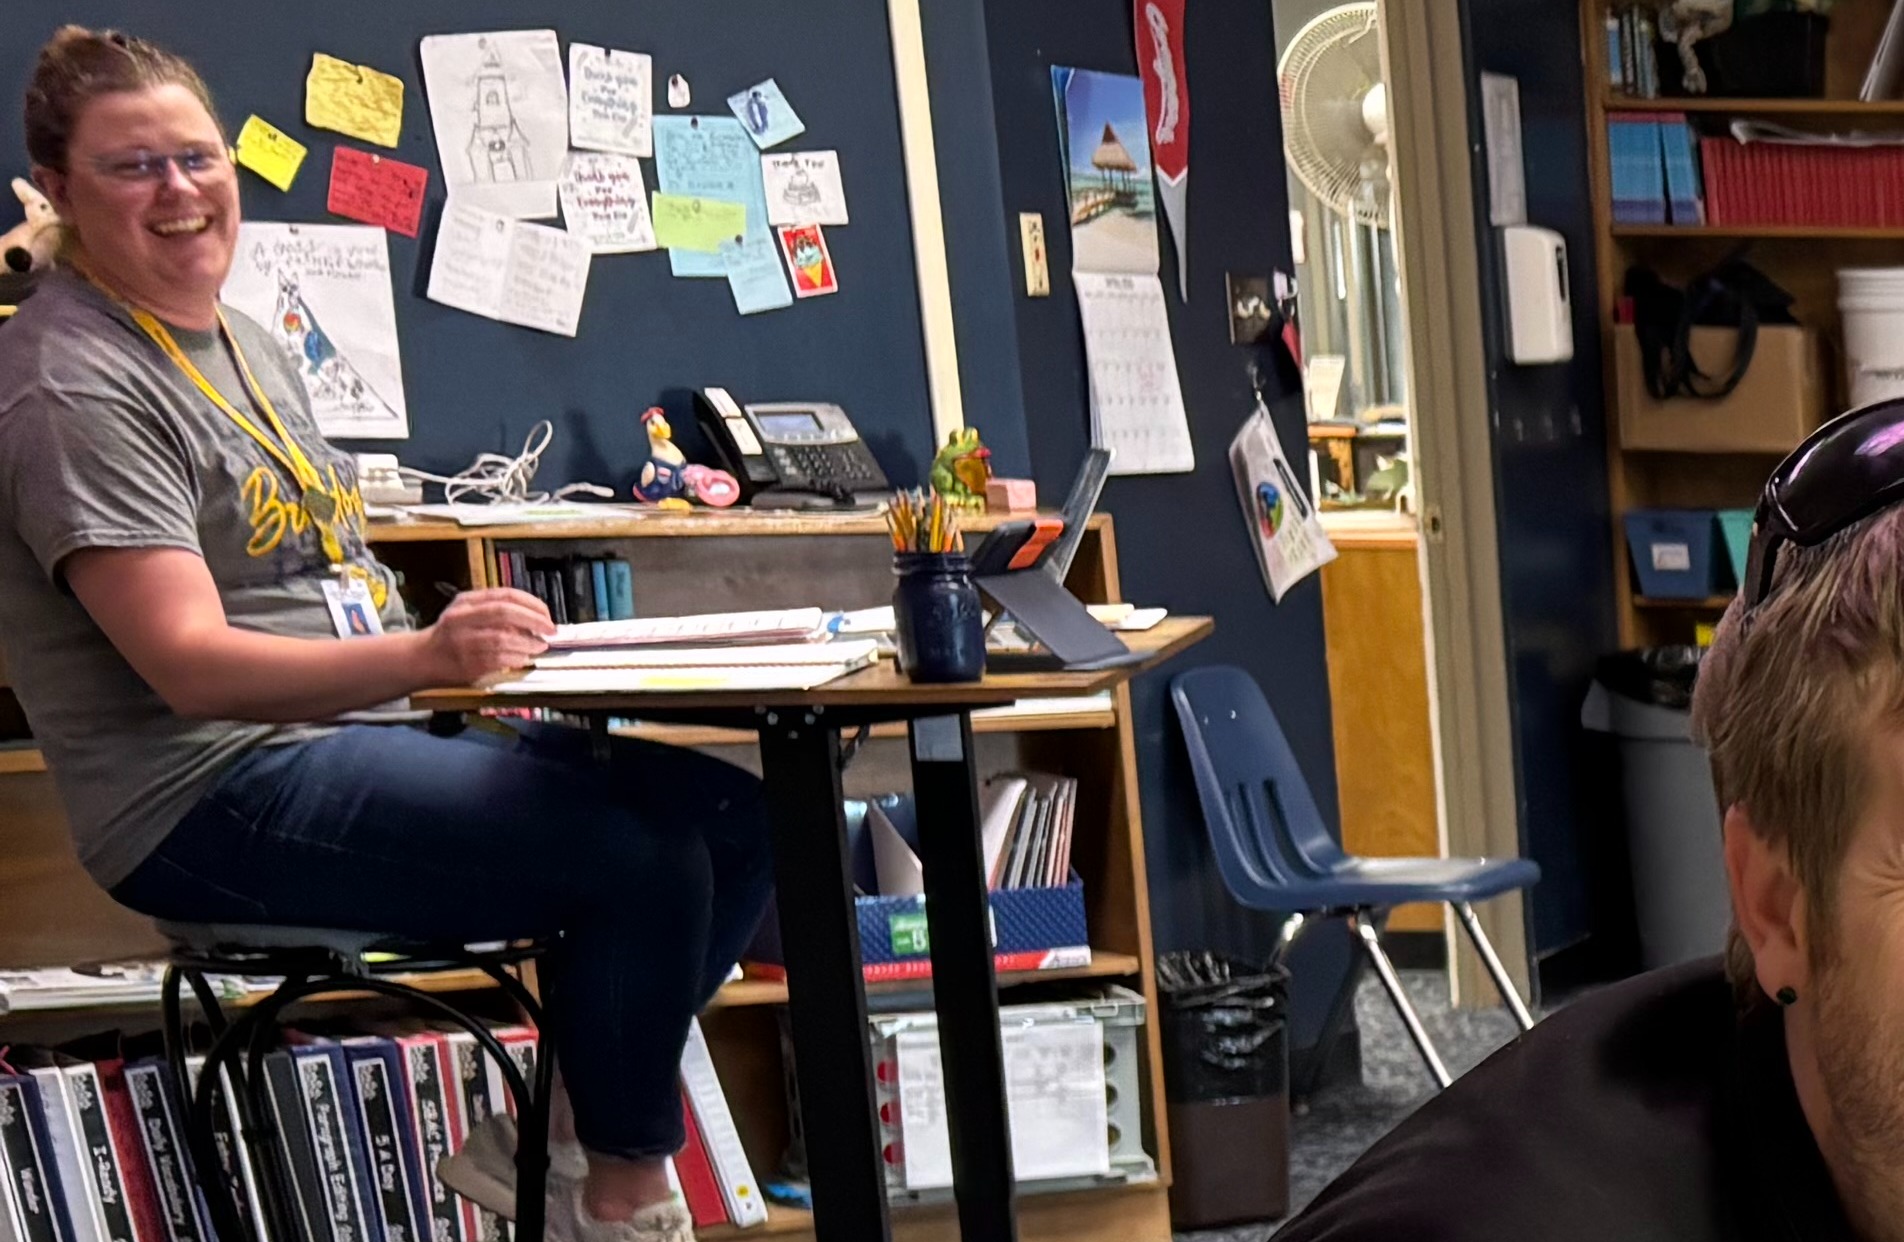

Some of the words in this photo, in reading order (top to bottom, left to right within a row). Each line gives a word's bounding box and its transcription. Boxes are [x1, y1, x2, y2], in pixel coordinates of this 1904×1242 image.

[314, 1102, 343, 1172] Paragraph
[375, 1133, 390, 1148] 5
[91, 1144, 118, 1205] I-Ready
[147, 1117, 169, 1151] Daily
[158, 1154, 186, 1226] Vocabulary
[328, 1173, 350, 1223] Editing
[380, 1163, 396, 1193] Day
